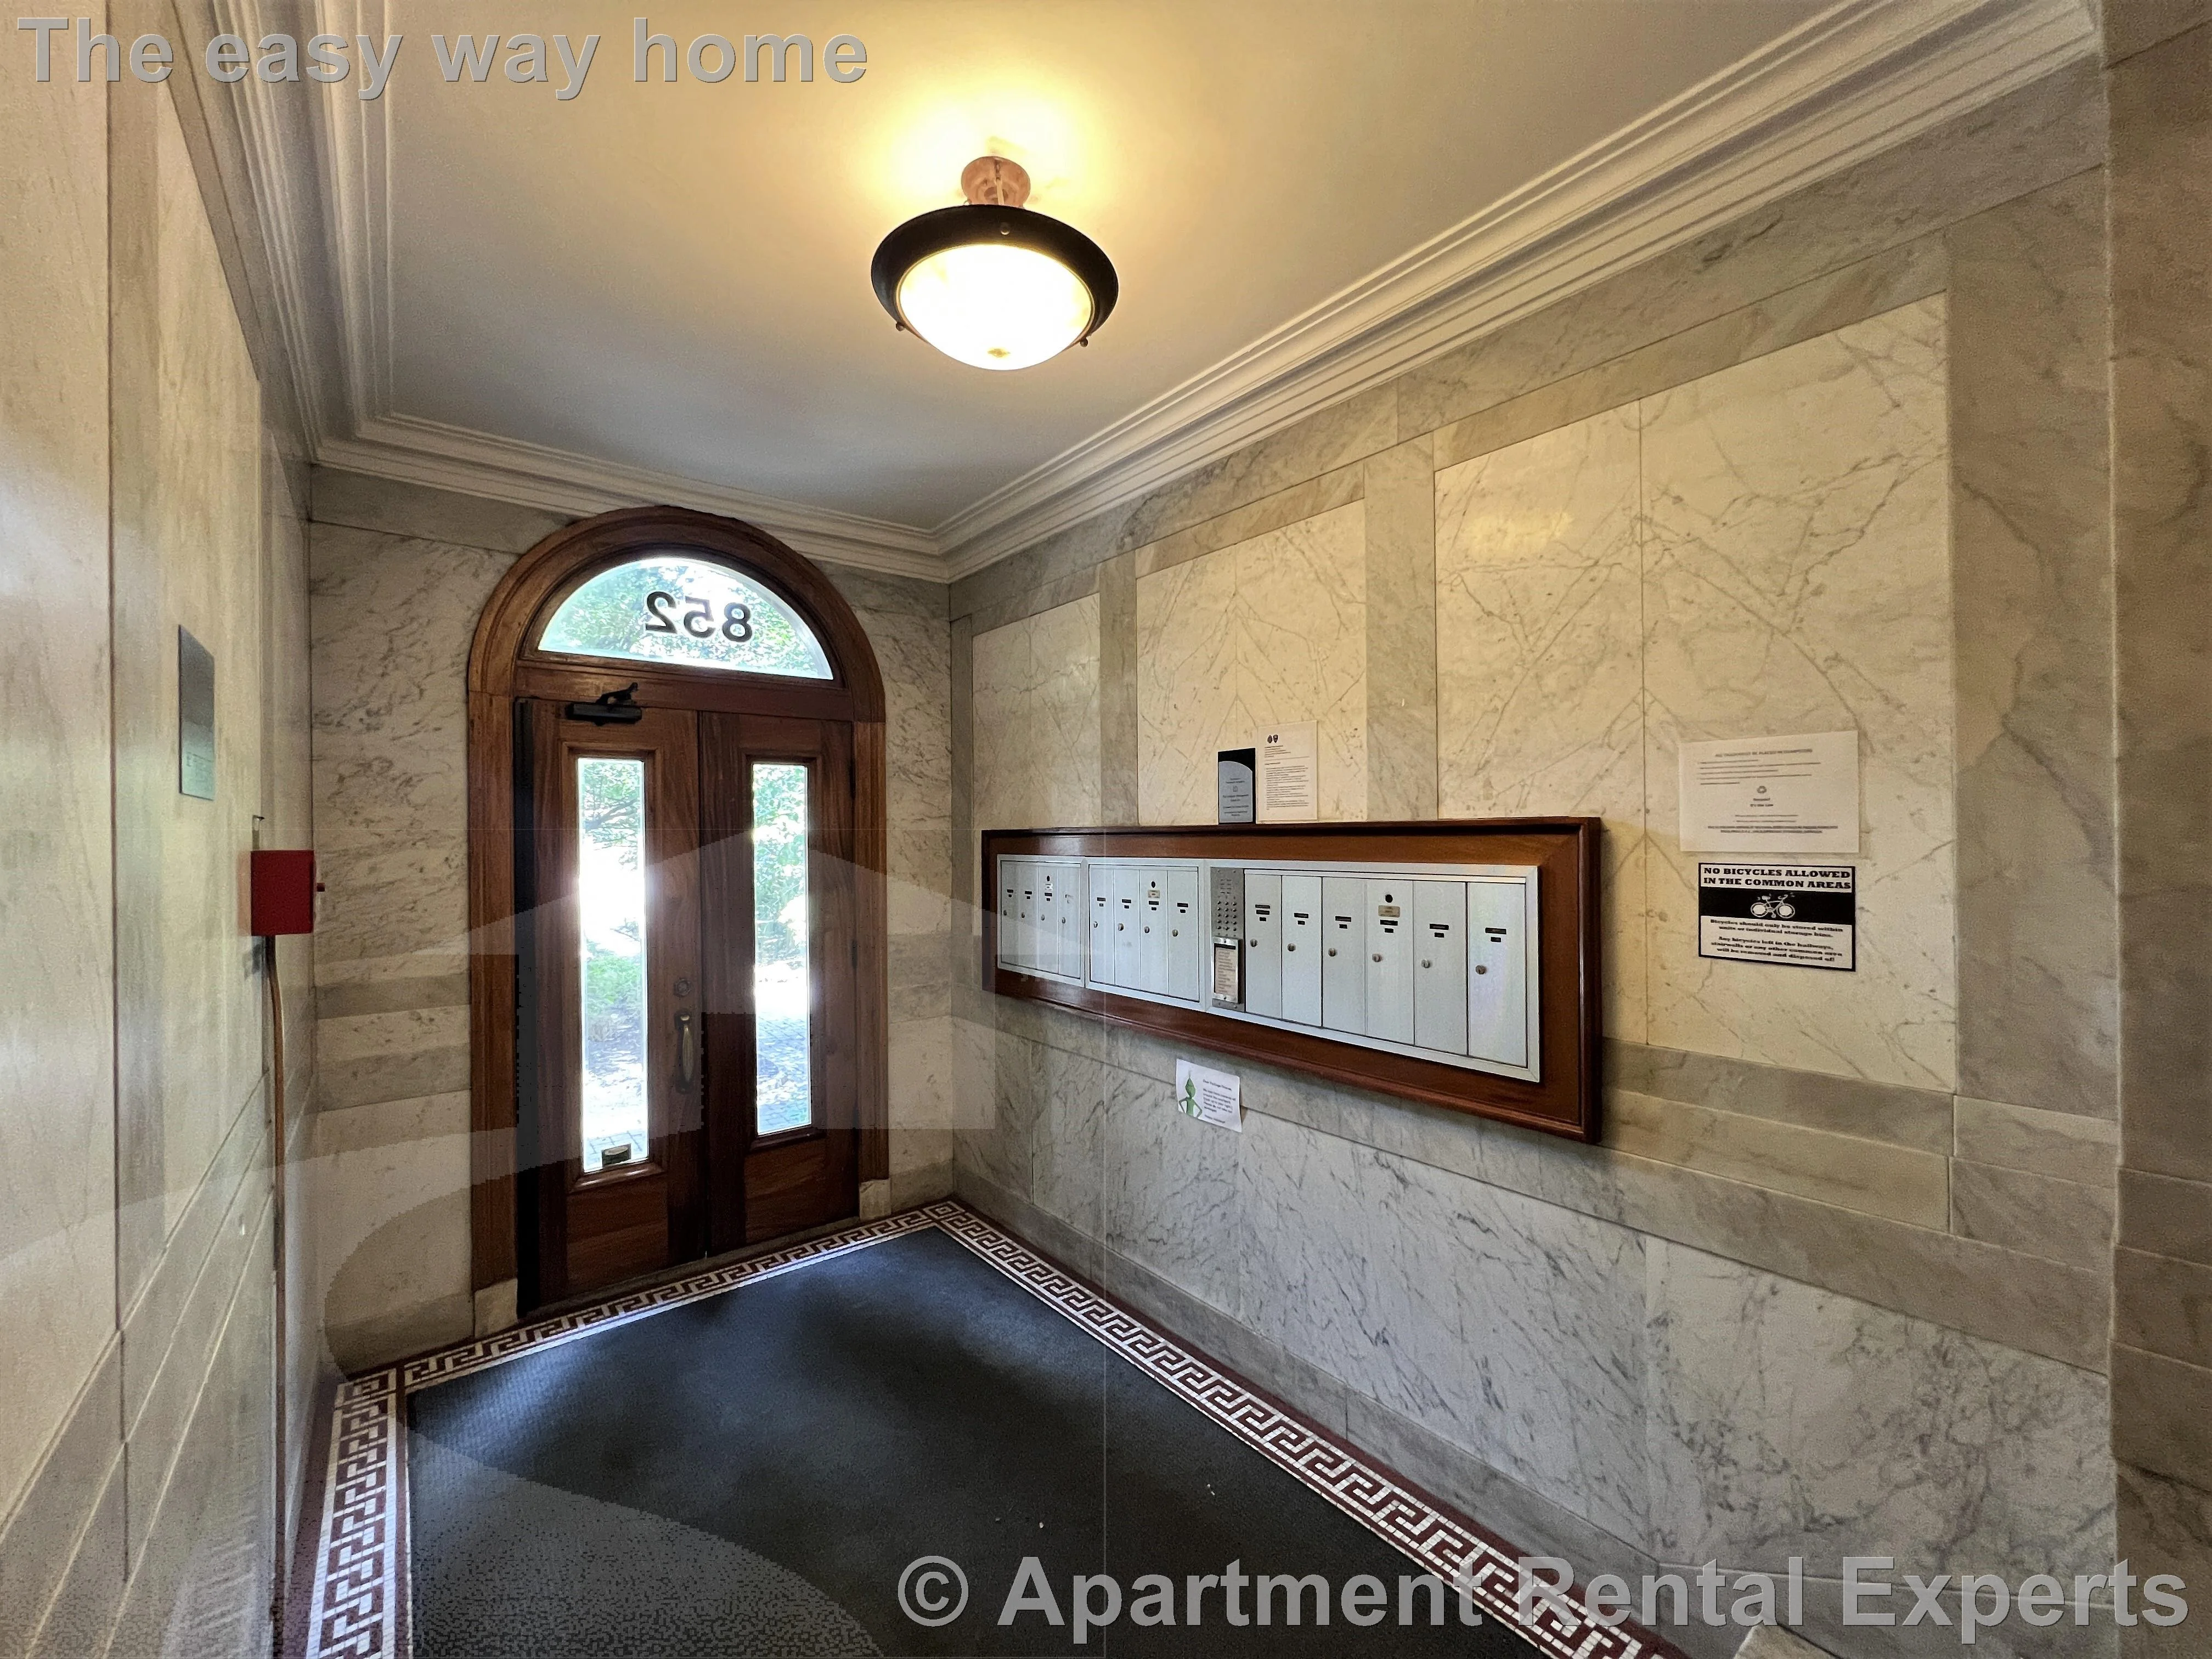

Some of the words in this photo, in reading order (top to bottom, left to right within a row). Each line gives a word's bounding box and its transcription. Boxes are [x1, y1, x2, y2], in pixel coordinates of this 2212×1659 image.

[1785, 870, 1850, 878] ALLOWED
[1745, 879, 1804, 888] COMMON
[1807, 881, 1851, 889] AREAS
